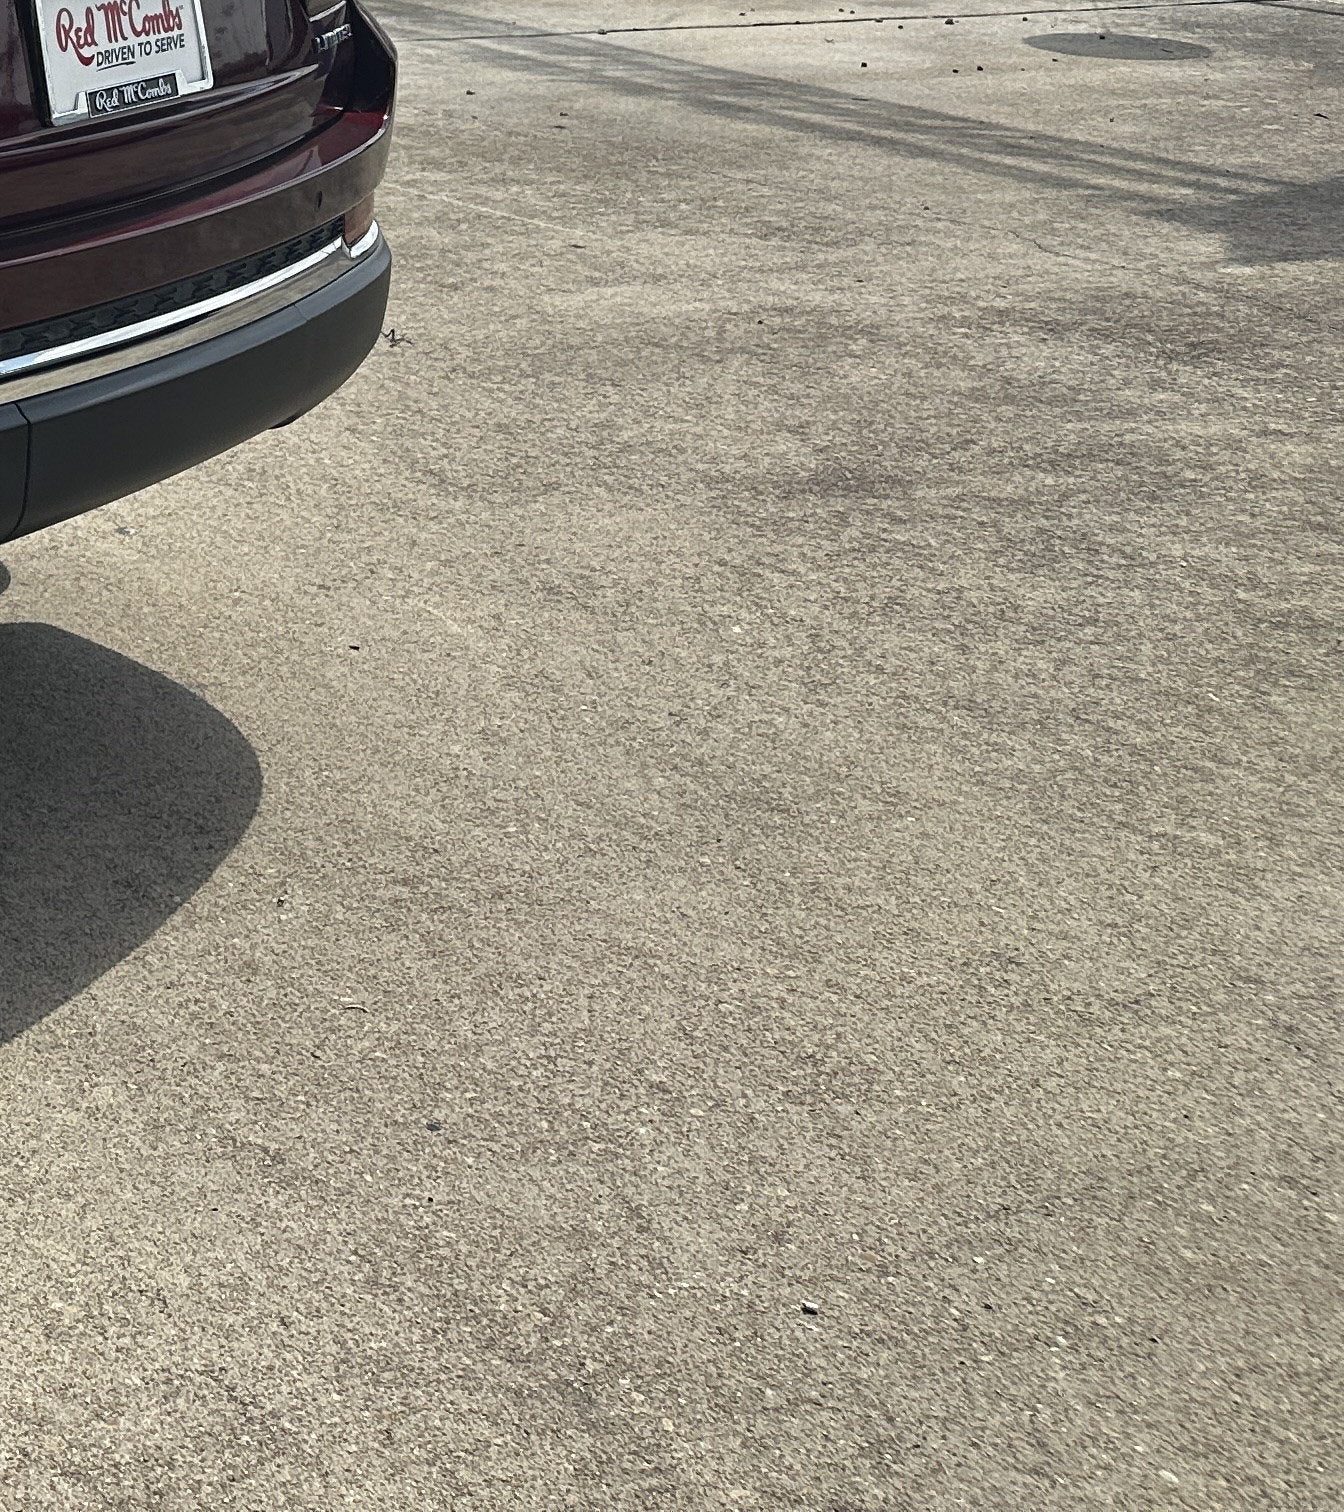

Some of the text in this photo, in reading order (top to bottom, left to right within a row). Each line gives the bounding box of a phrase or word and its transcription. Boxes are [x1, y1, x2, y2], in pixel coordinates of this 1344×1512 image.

[55, 6, 98, 67] Red
[96, 33, 185, 67] DRIVEN TO SERVE
[95, 78, 172, 112] Red McCombs
